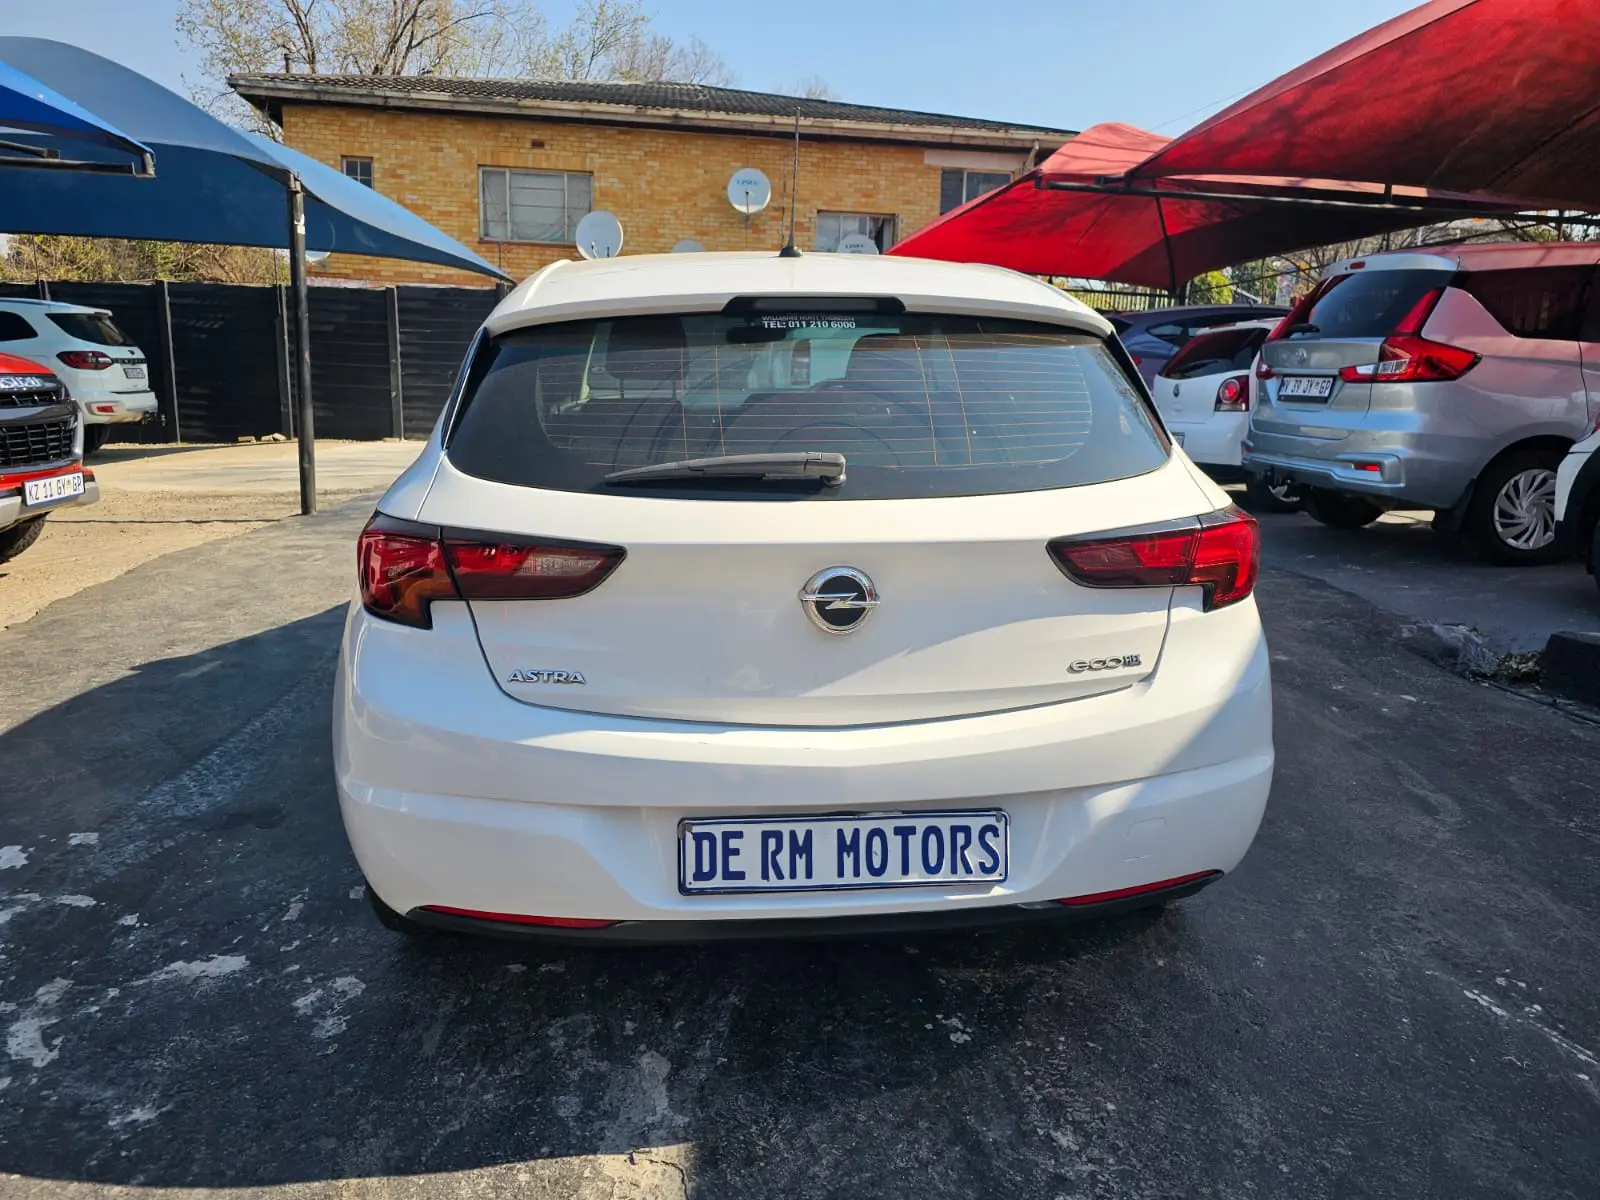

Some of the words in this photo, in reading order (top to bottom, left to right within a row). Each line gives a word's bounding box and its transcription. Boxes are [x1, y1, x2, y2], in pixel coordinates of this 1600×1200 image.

[762, 321, 786, 329] TEL:
[788, 320, 806, 328] 011
[810, 320, 829, 328] 210
[831, 321, 856, 329] 6000
[0, 376, 42, 389] SUZU
[1319, 379, 1331, 395] GP
[28, 482, 40, 500] KZ
[43, 482, 54, 498] 11
[56, 478, 67, 496] GY
[72, 475, 82, 492] GP
[507, 668, 586, 684] ASTRA
[692, 830, 746, 882] DE
[761, 828, 813, 881] RM
[836, 823, 1000, 878] MOTORS
